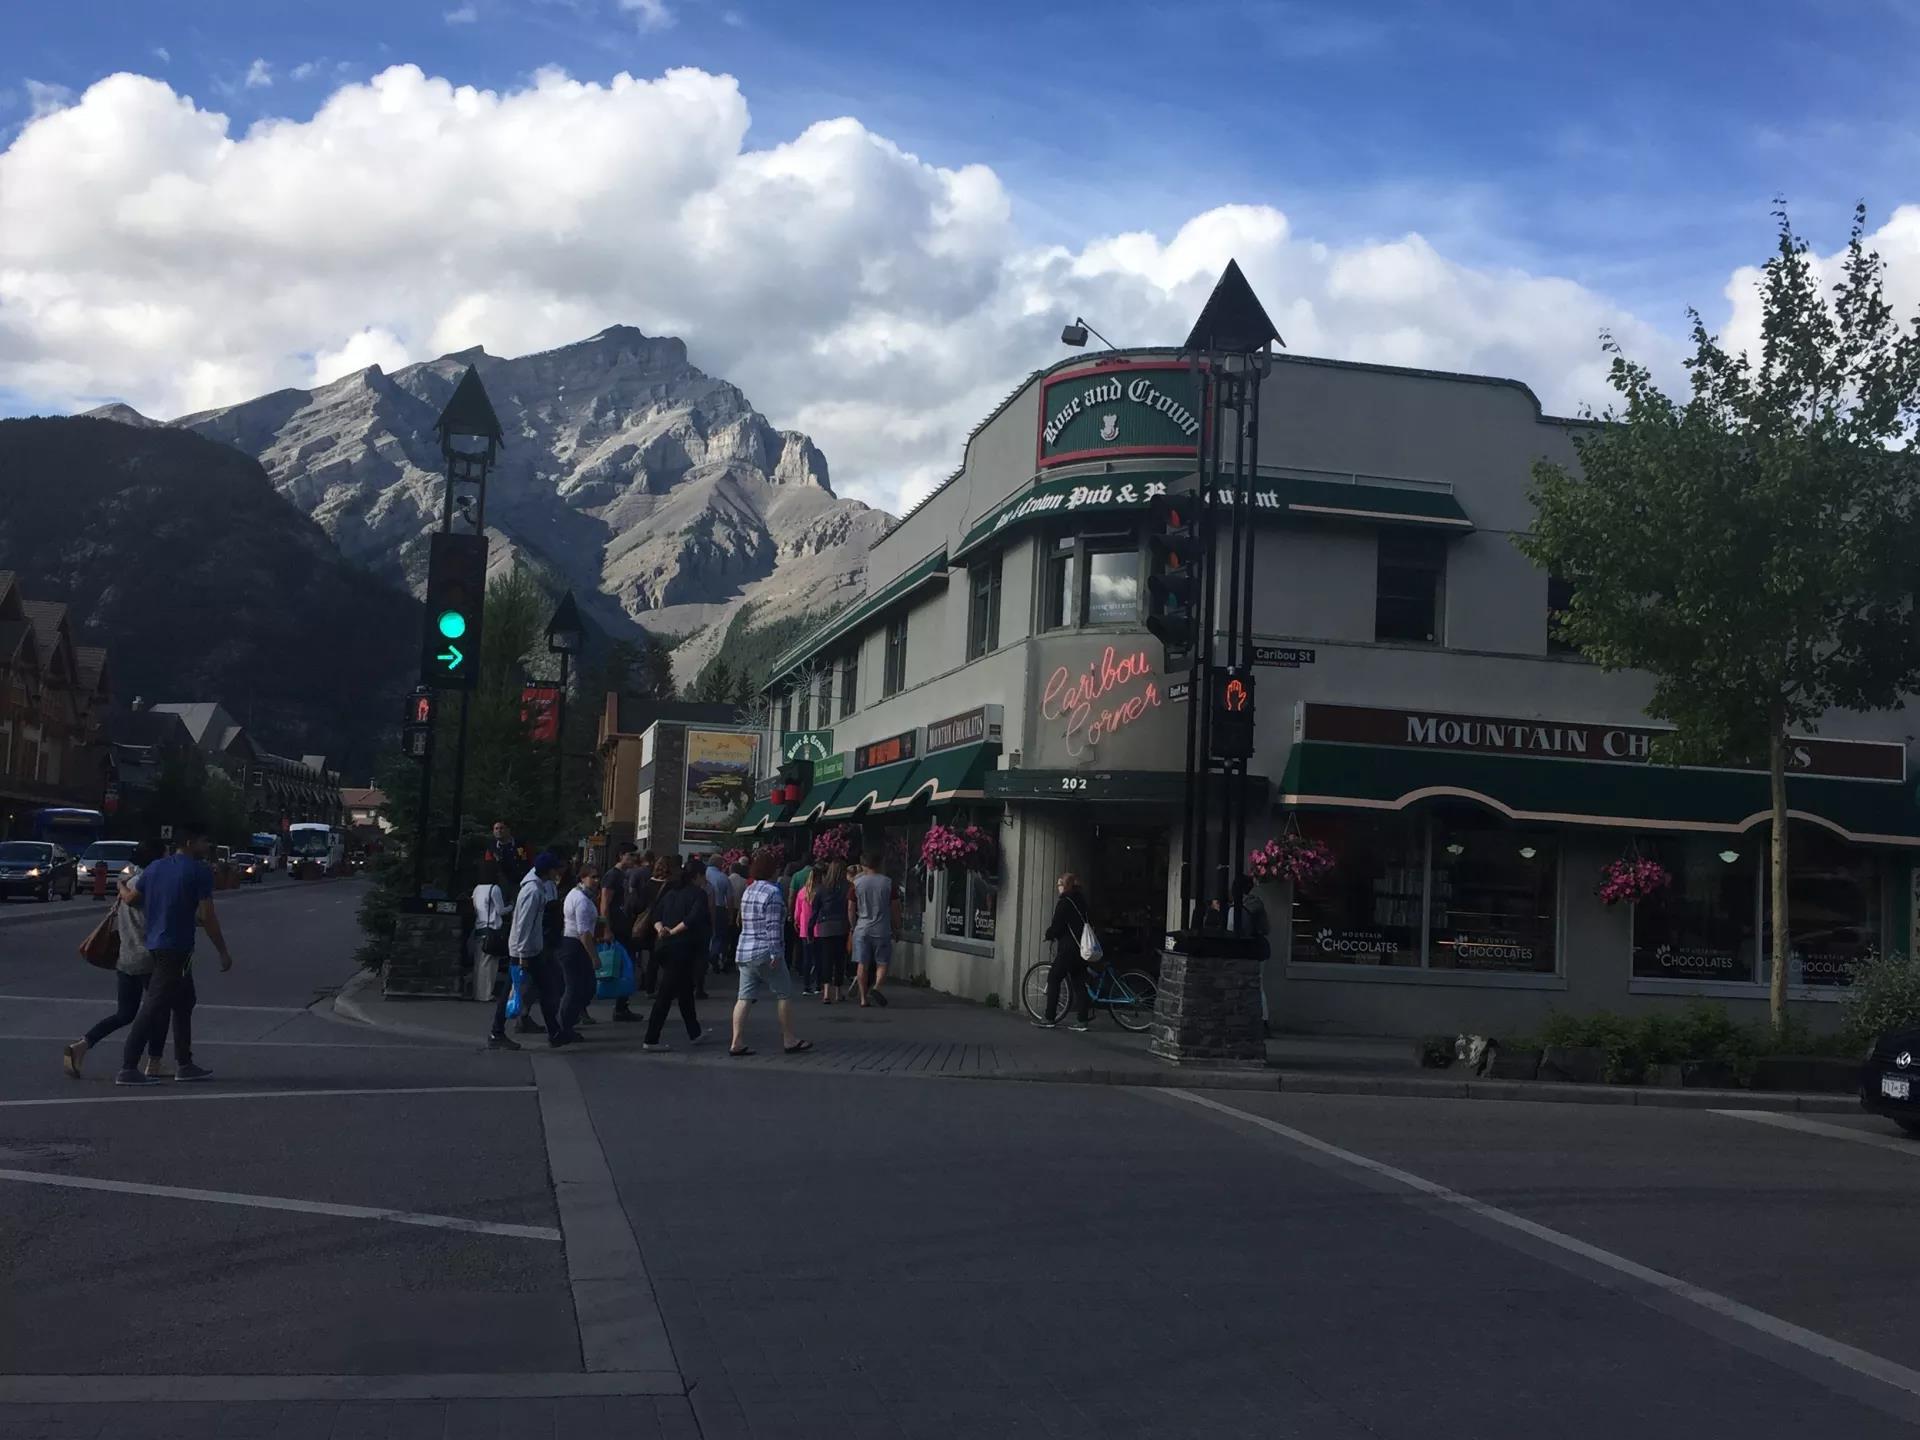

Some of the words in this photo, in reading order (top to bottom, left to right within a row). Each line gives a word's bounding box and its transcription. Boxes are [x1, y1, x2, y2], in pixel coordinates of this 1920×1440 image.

[1043, 397, 1082, 447] Rose
[1084, 376, 1122, 407] and
[1128, 377, 1200, 437] Crown
[1064, 484, 1113, 510] Pub
[1116, 483, 1139, 503] &
[1256, 648, 1296, 661] Caribou
[1298, 651, 1311, 662] St
[1042, 646, 1151, 721] Caribou
[1066, 682, 1161, 757] Corner
[1406, 716, 1588, 753] MOUNTAIN
[1062, 778, 1087, 790] 202
[1321, 938, 1399, 953] CHOCOLATES
[1457, 945, 1533, 960] CHOCOLATES
[1660, 953, 1734, 968] CHOCOLATES
